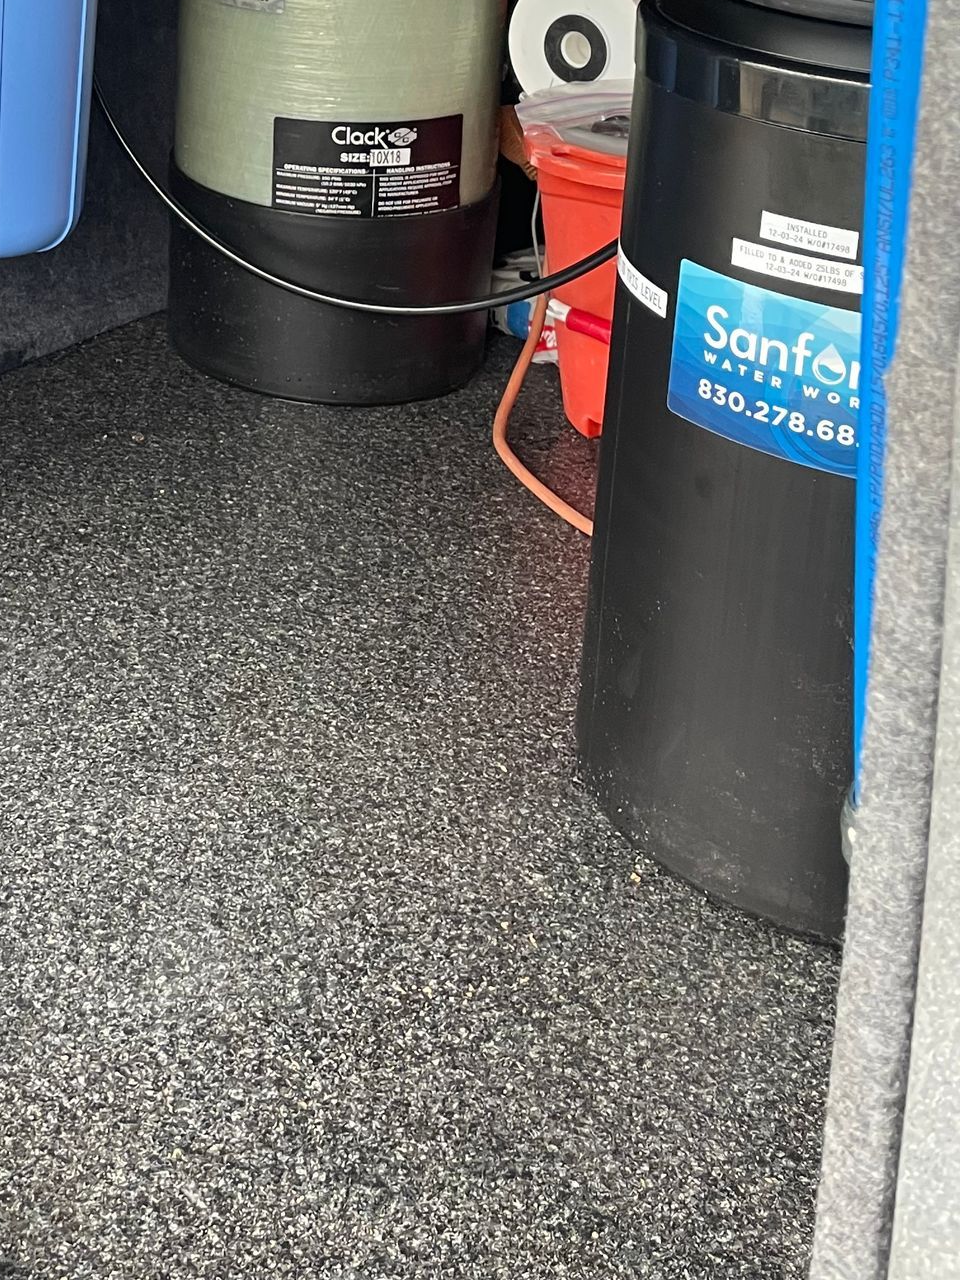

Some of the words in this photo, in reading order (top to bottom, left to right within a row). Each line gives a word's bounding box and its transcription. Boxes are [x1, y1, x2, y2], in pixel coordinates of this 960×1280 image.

[331, 126, 388, 149] Clack
[284, 164, 317, 172] OPERATING
[340, 152, 370, 162] SIZE:
[371, 151, 401, 164] 10X18
[416, 162, 450, 171] INSTRUCTIONS
[769, 228, 803, 243] 12-03-24
[807, 239, 850, 254] W/O#17498
[787, 222, 828, 238] INSTALLED
[740, 245, 764, 258] FILLED
[768, 253, 777, 261] TO
[790, 259, 812, 269] ADDED
[816, 264, 840, 275] 25LBS
[766, 263, 800, 277] 12-03-24
[804, 273, 847, 287] W/O#17498
[641, 283, 662, 309] LEVEL
[704, 350, 782, 389] WATER
[698, 378, 860, 448] 830.278.68
